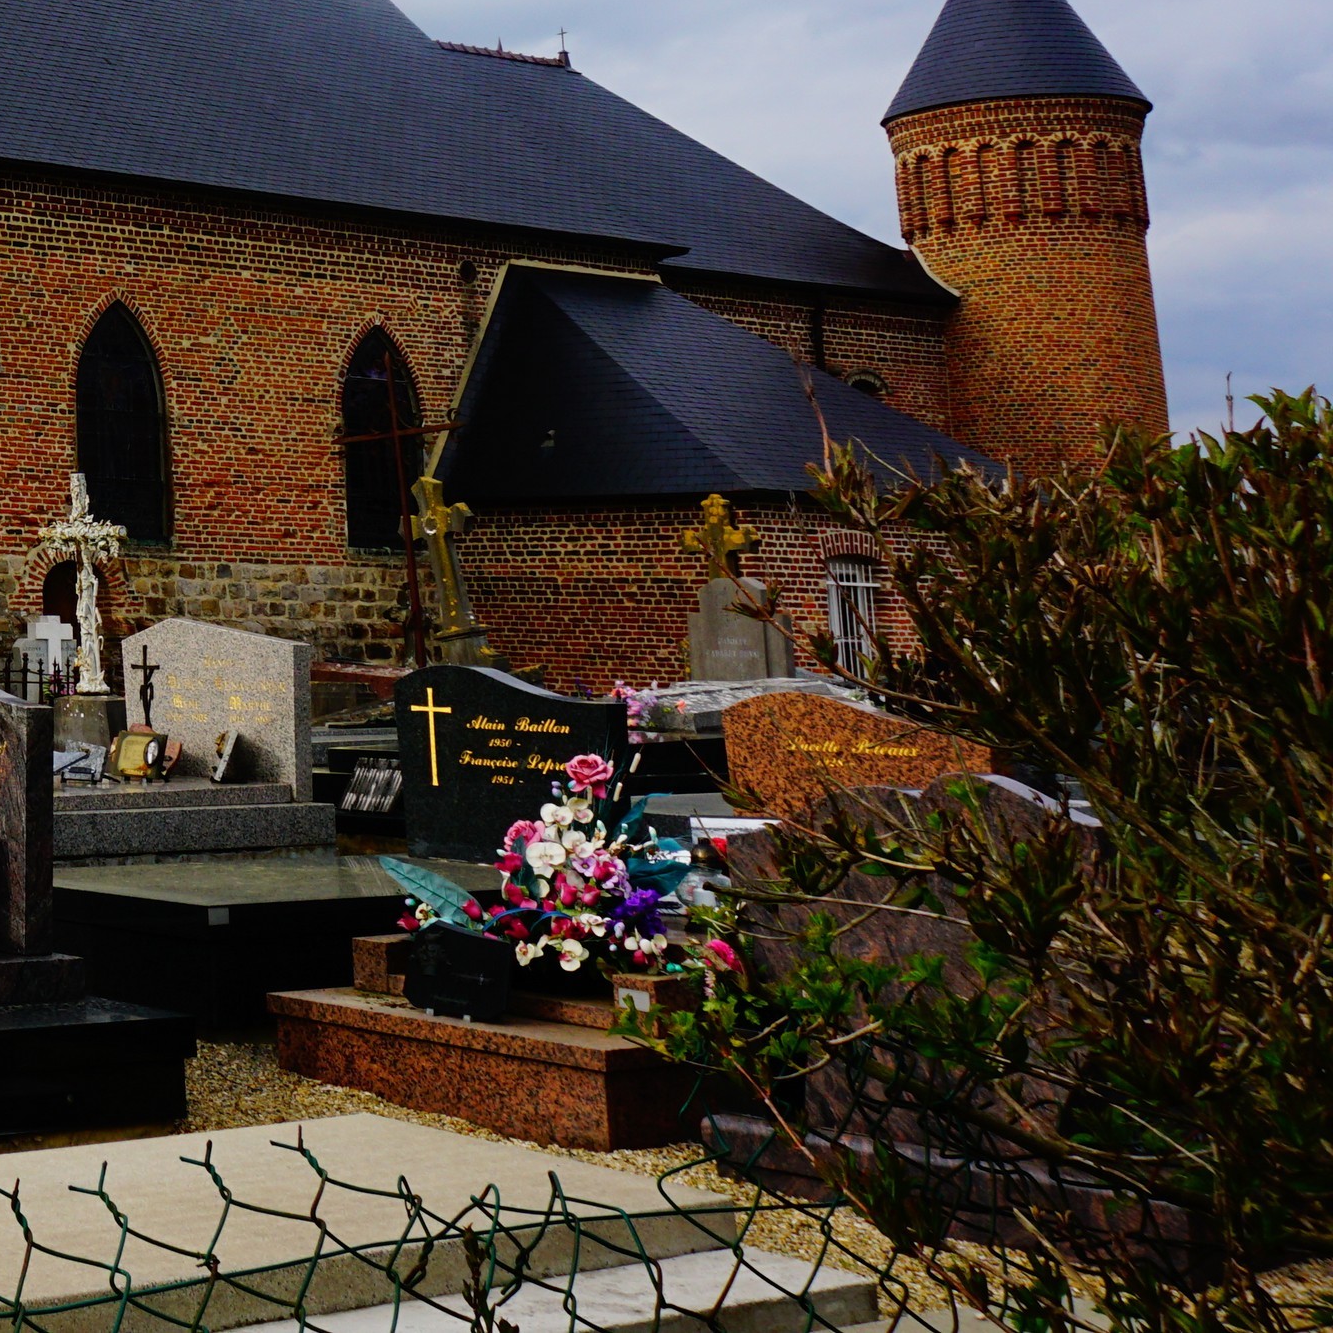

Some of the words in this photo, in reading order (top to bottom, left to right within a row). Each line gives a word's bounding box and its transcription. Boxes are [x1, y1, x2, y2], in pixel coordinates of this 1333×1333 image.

[466, 715, 506, 730] Alain
[515, 716, 570, 734] Baillon
[488, 738, 512, 747] 1950
[459, 750, 518, 769] Françoise
[527, 754, 566, 775] Lepre
[491, 775, 514, 785] 1951
